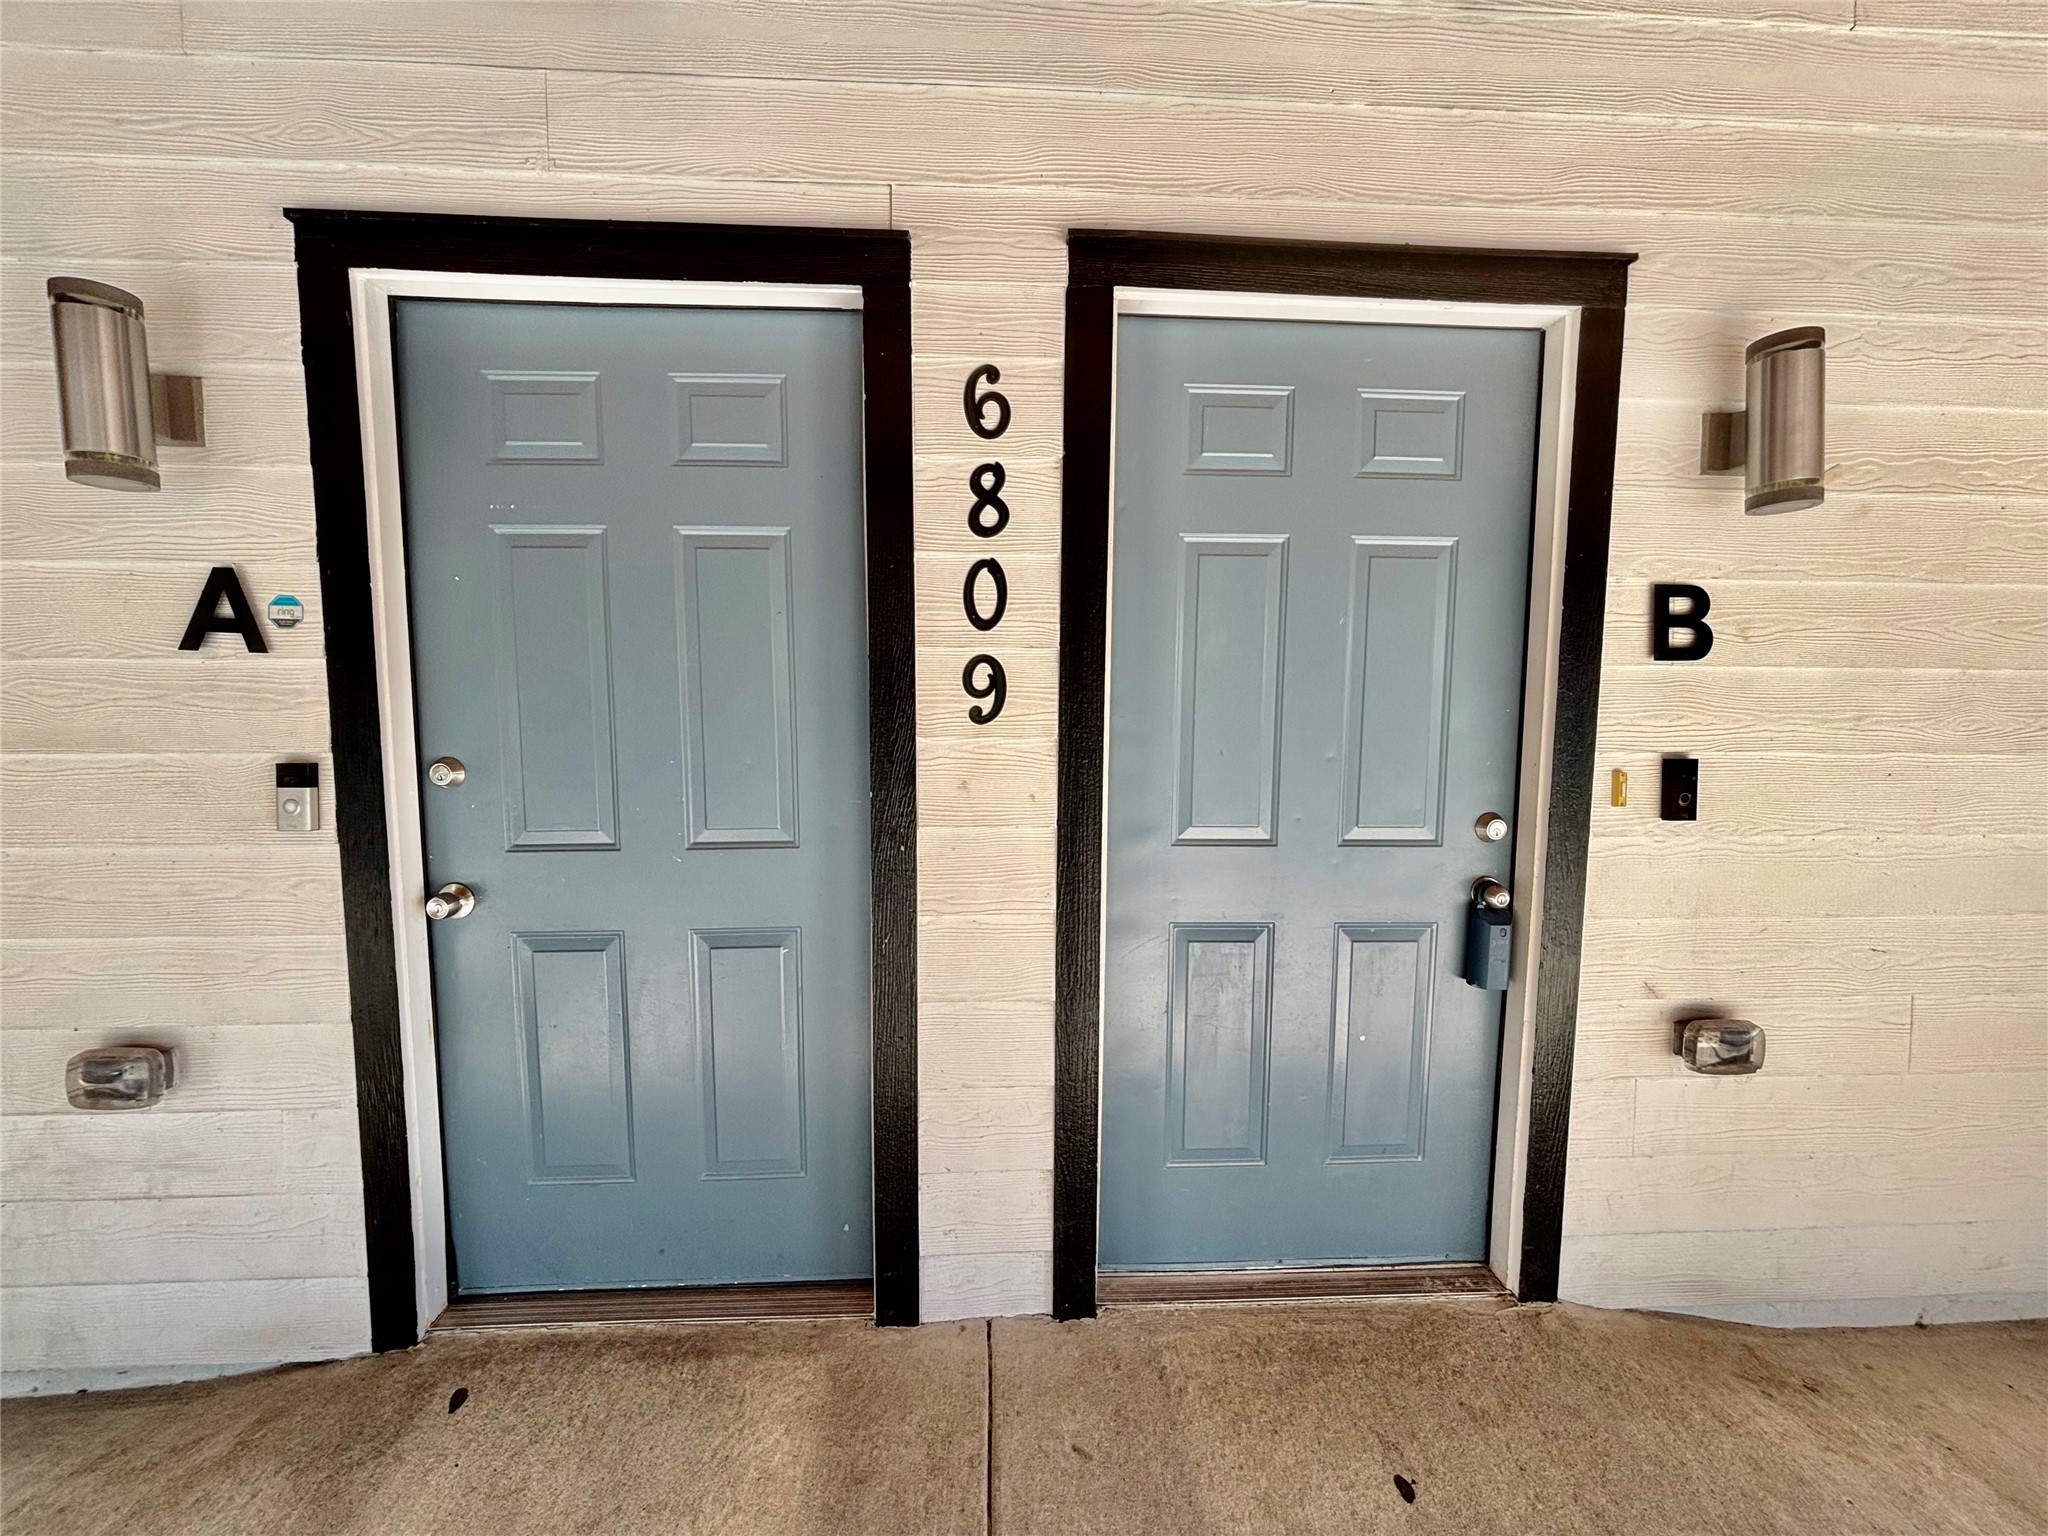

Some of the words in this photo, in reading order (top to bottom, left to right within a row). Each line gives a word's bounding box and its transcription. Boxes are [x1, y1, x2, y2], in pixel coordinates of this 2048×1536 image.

[963, 364, 1011, 725] 6809
[178, 566, 269, 654] A
[277, 607, 295, 617] ring
[1653, 584, 1713, 661] B
